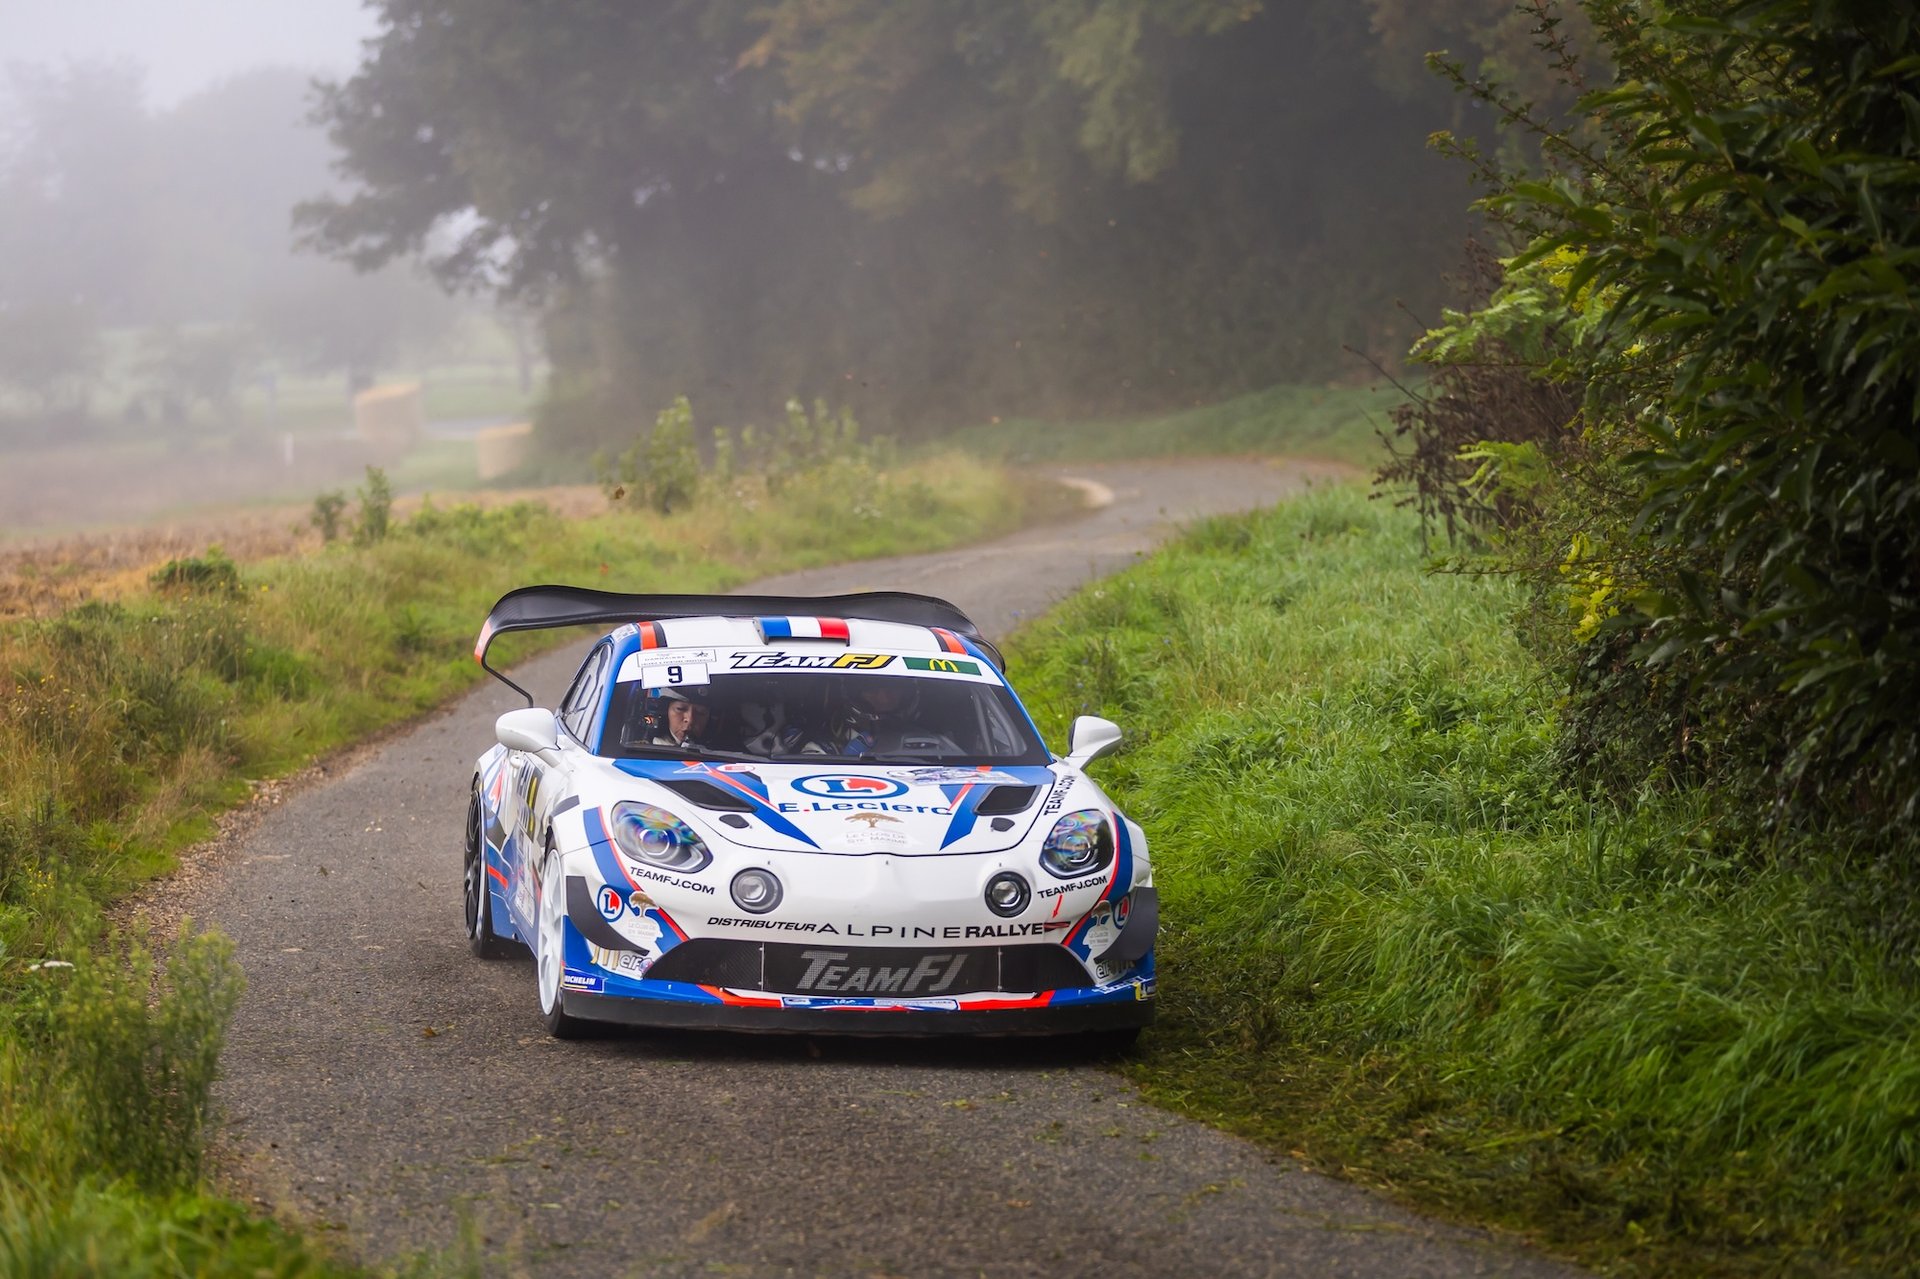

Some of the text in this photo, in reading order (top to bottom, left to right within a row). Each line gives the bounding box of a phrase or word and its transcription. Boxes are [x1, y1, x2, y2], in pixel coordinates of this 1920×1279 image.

[667, 665, 683, 684] 9
[778, 801, 953, 816] E.Leclerc
[630, 866, 716, 896] TEAMFJ.COM
[1037, 875, 1108, 899] TEAMFJ.COM
[707, 917, 1043, 939] DISTRIBUTEUR ALPINE RALLYE
